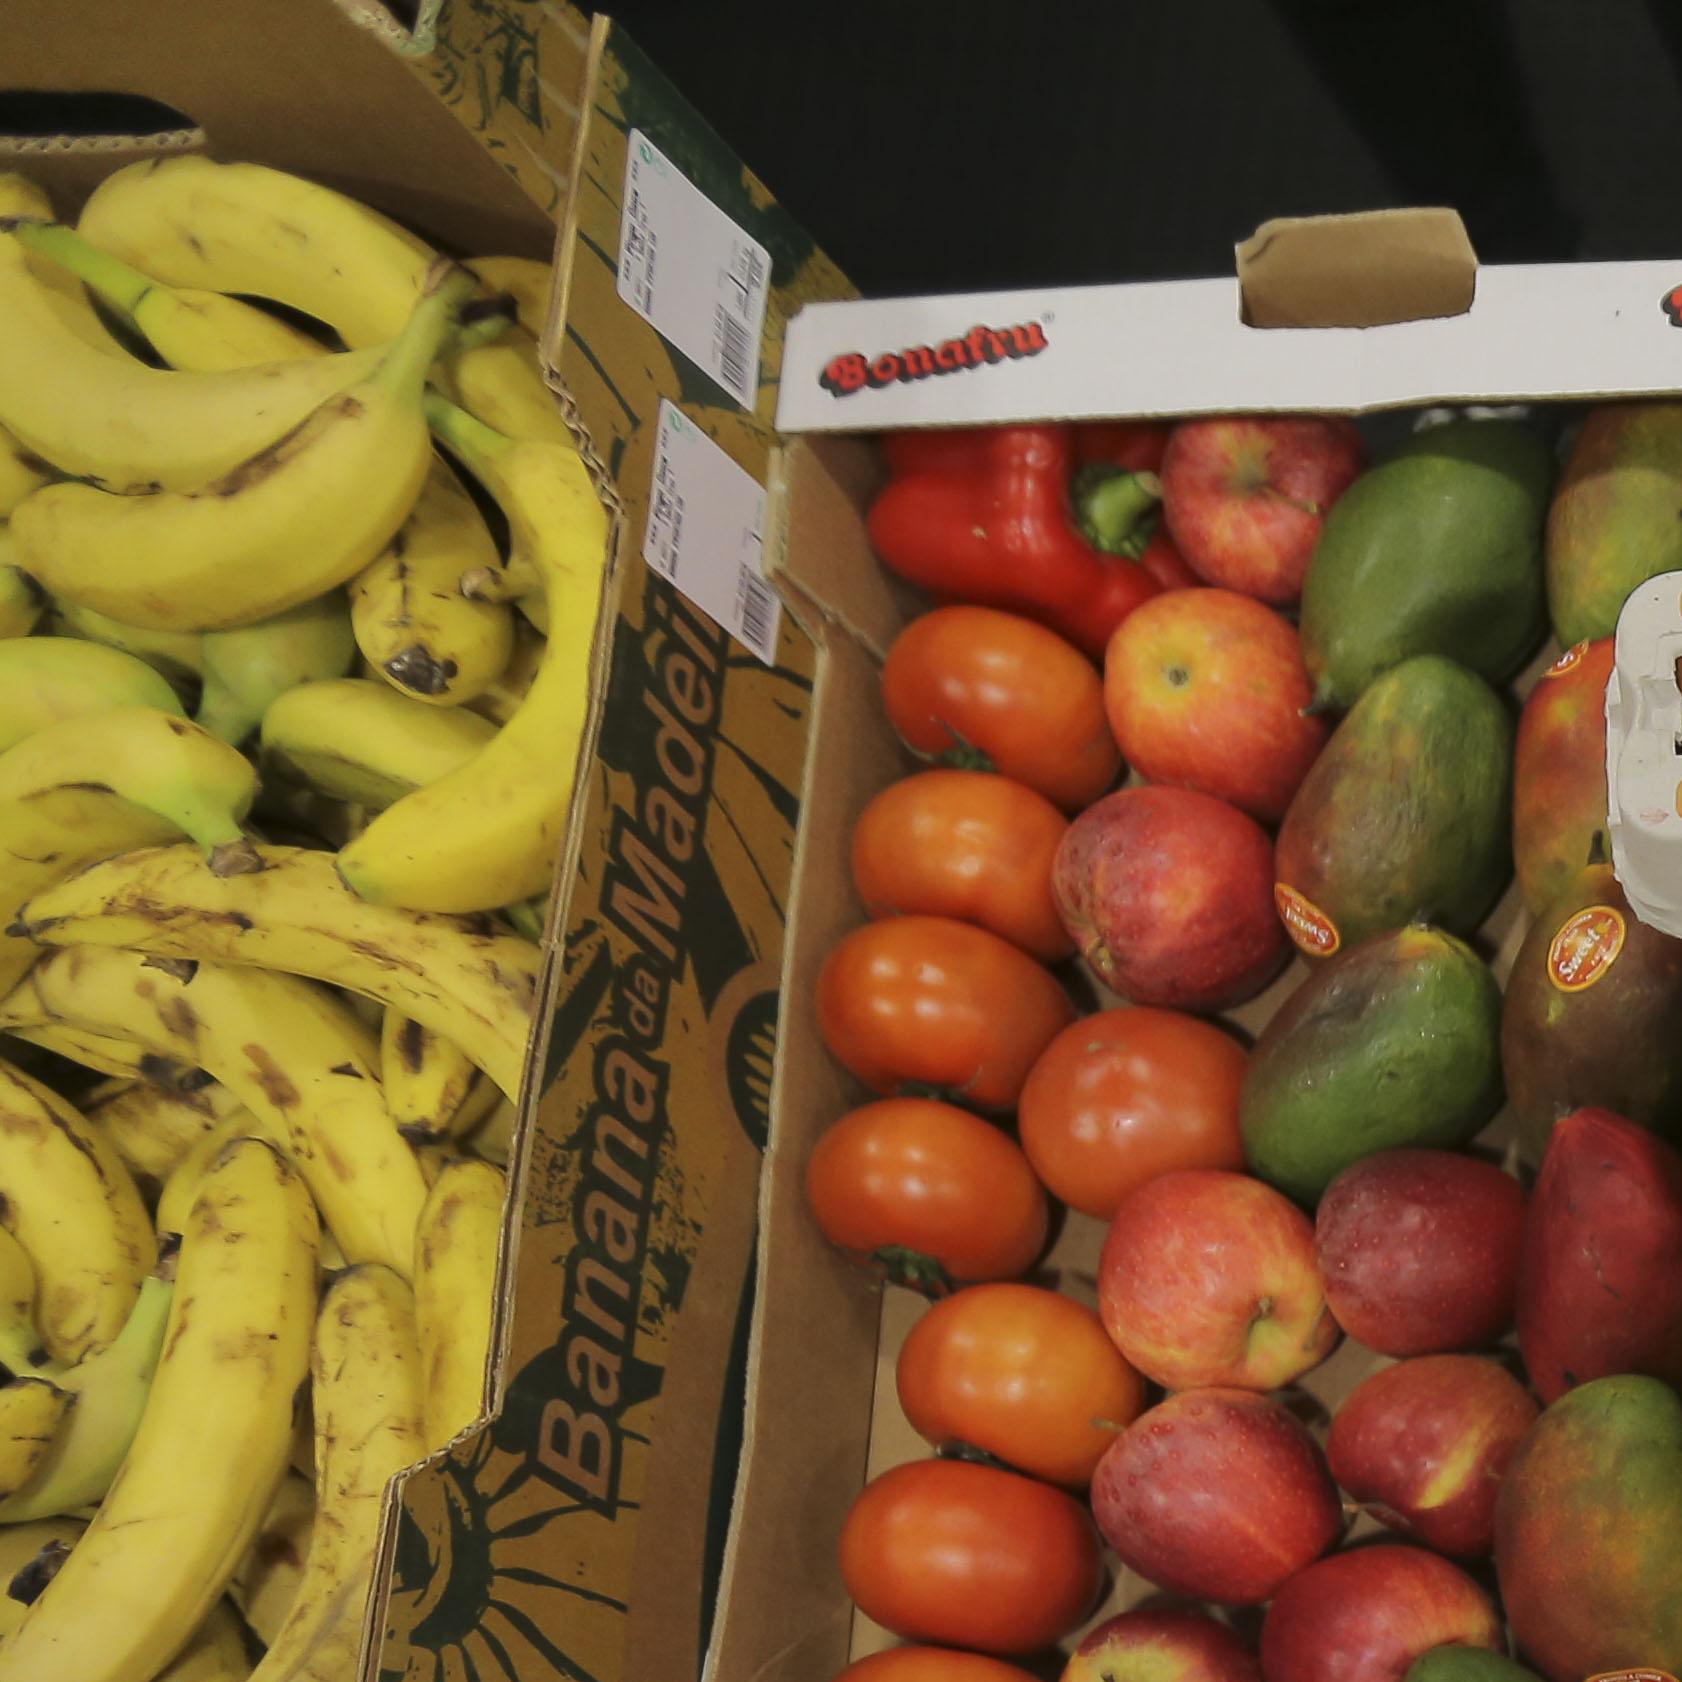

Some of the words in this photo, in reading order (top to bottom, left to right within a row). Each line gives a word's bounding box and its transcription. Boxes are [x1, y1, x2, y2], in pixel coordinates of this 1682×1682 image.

[816, 318, 1049, 398] Bonafru
[1559, 923, 1601, 976] Sweet
[534, 1048, 660, 1503] Banana
[626, 966, 662, 1039] da
